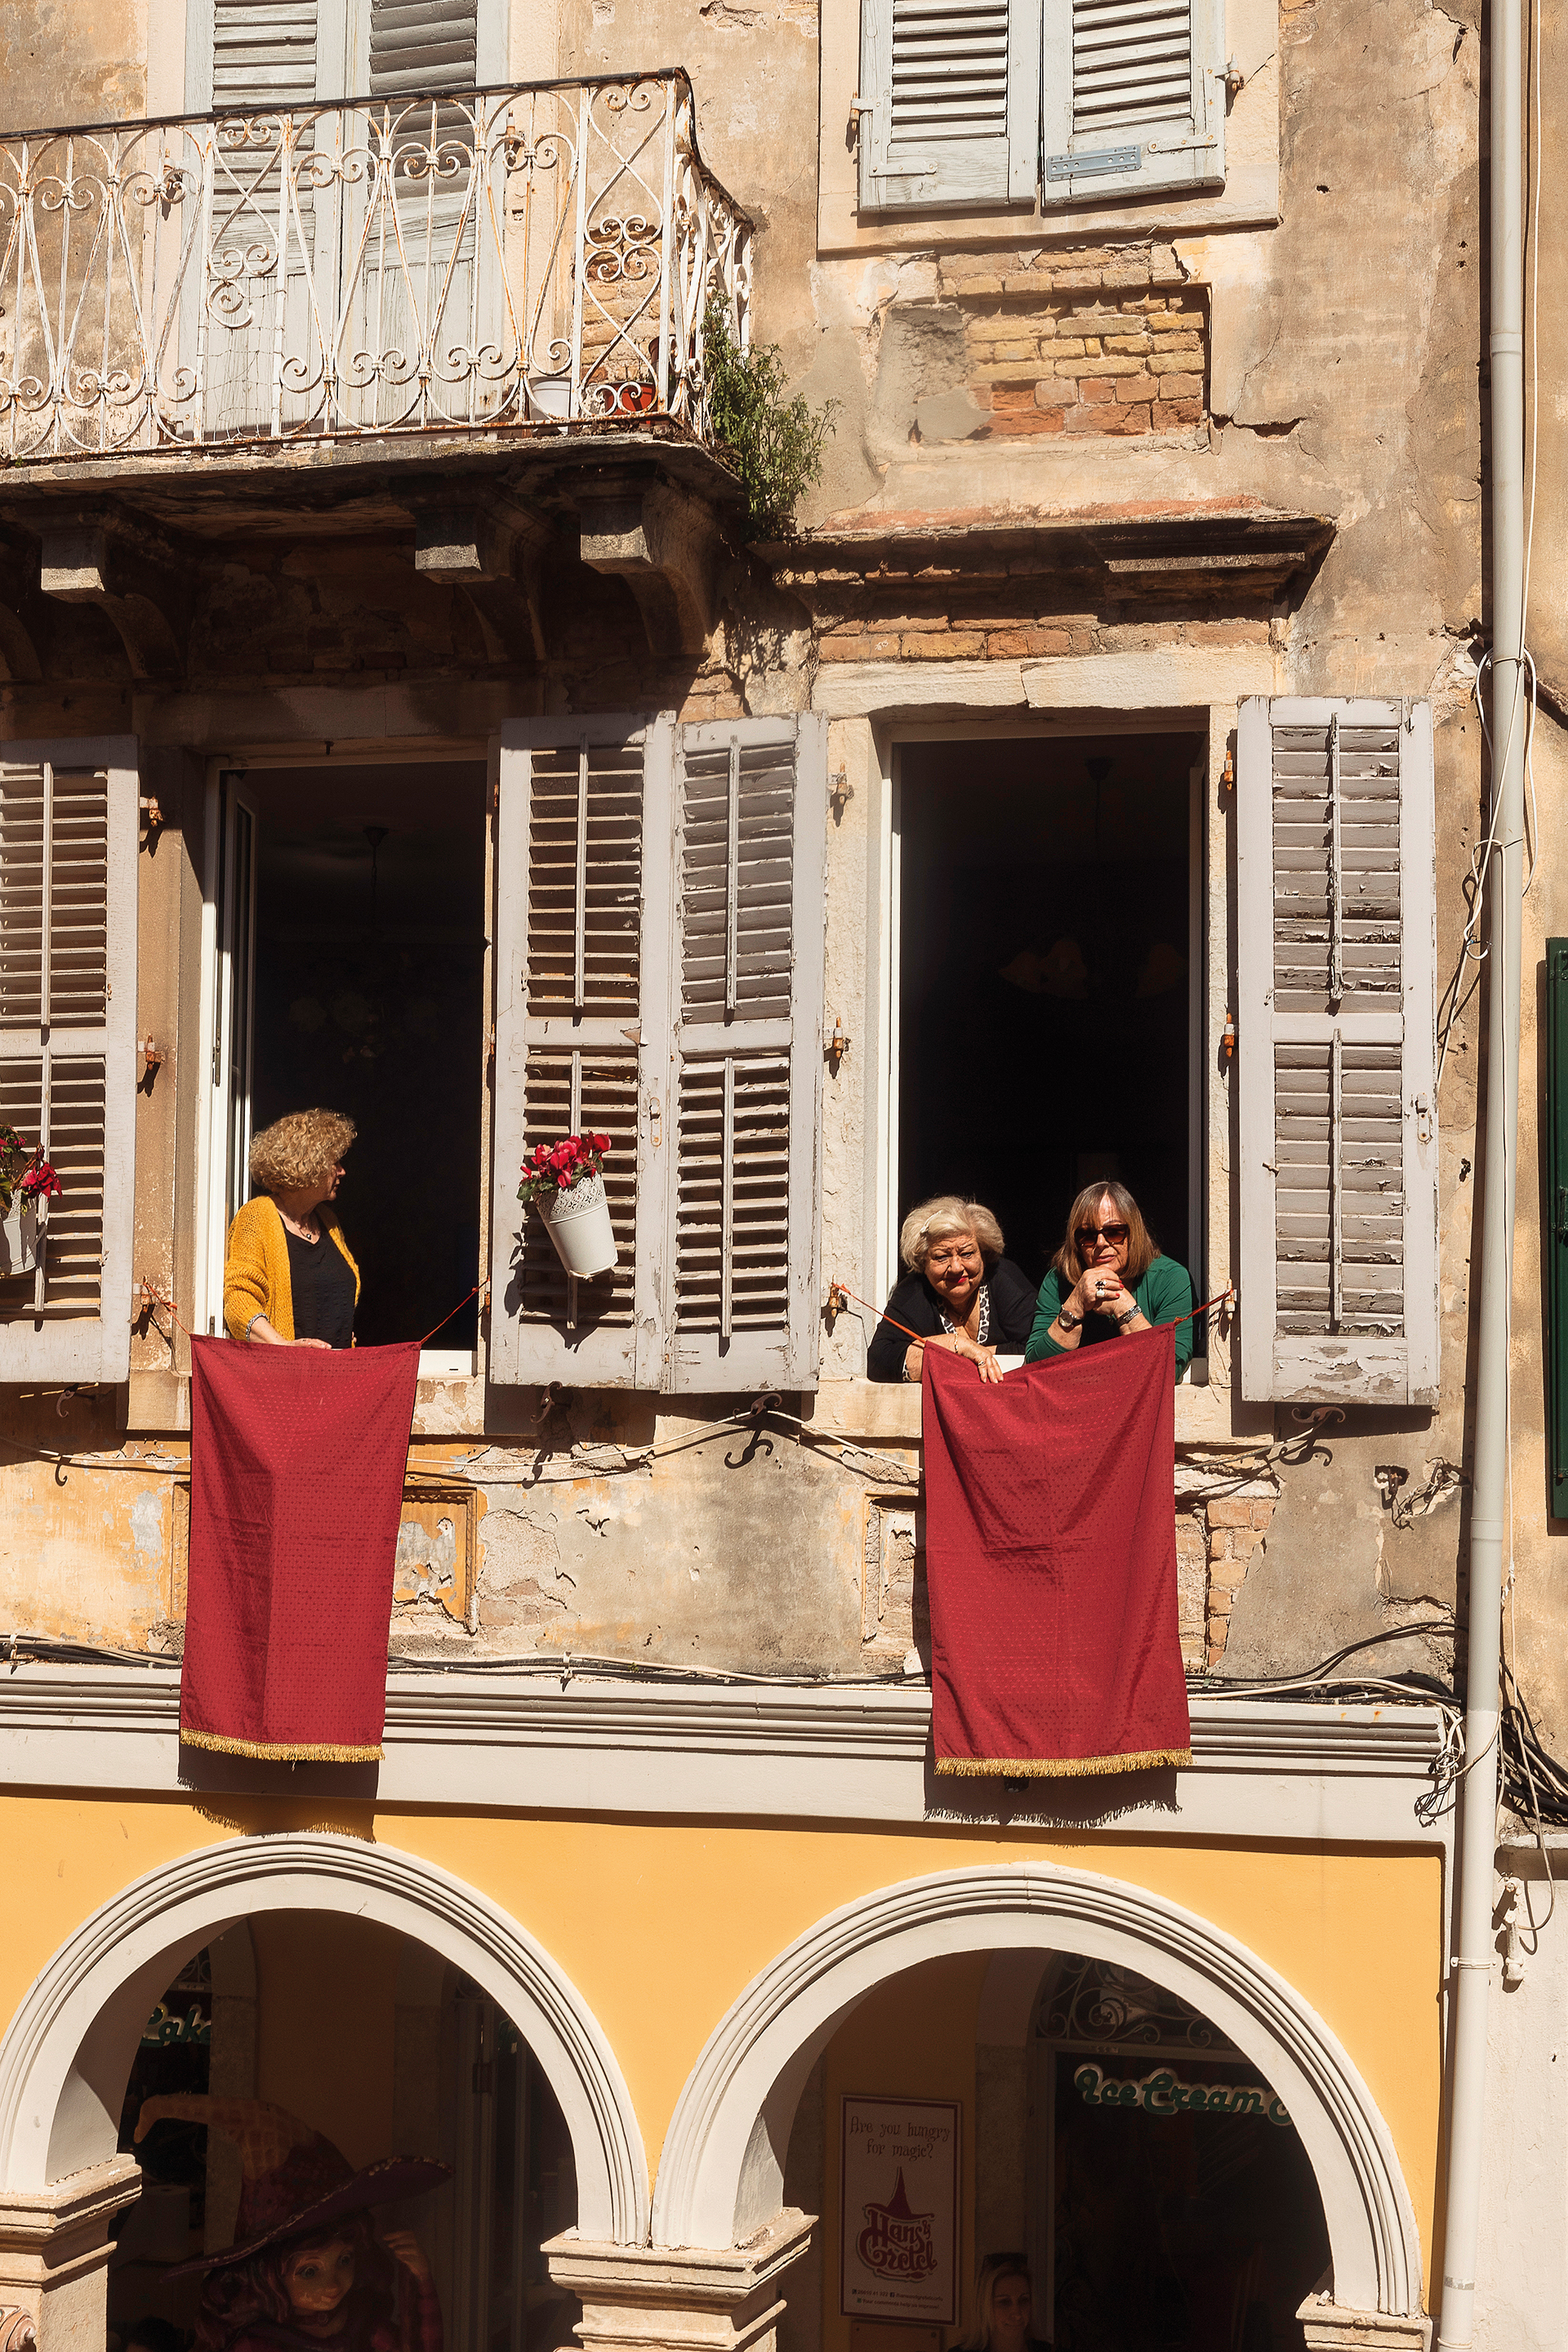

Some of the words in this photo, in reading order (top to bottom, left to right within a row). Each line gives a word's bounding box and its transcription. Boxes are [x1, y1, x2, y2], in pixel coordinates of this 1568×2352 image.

[1076, 2068, 1138, 2107] Ice
[1142, 2072, 1265, 2115] Cream
[849, 2115, 873, 2135] Are
[880, 2123, 901, 2138] you
[906, 2122, 951, 2142] hungry
[866, 2138, 885, 2156] for
[892, 2142, 933, 2162] magic?
[859, 2226, 938, 2271] Gretel
[867, 2209, 925, 2253] Hans
